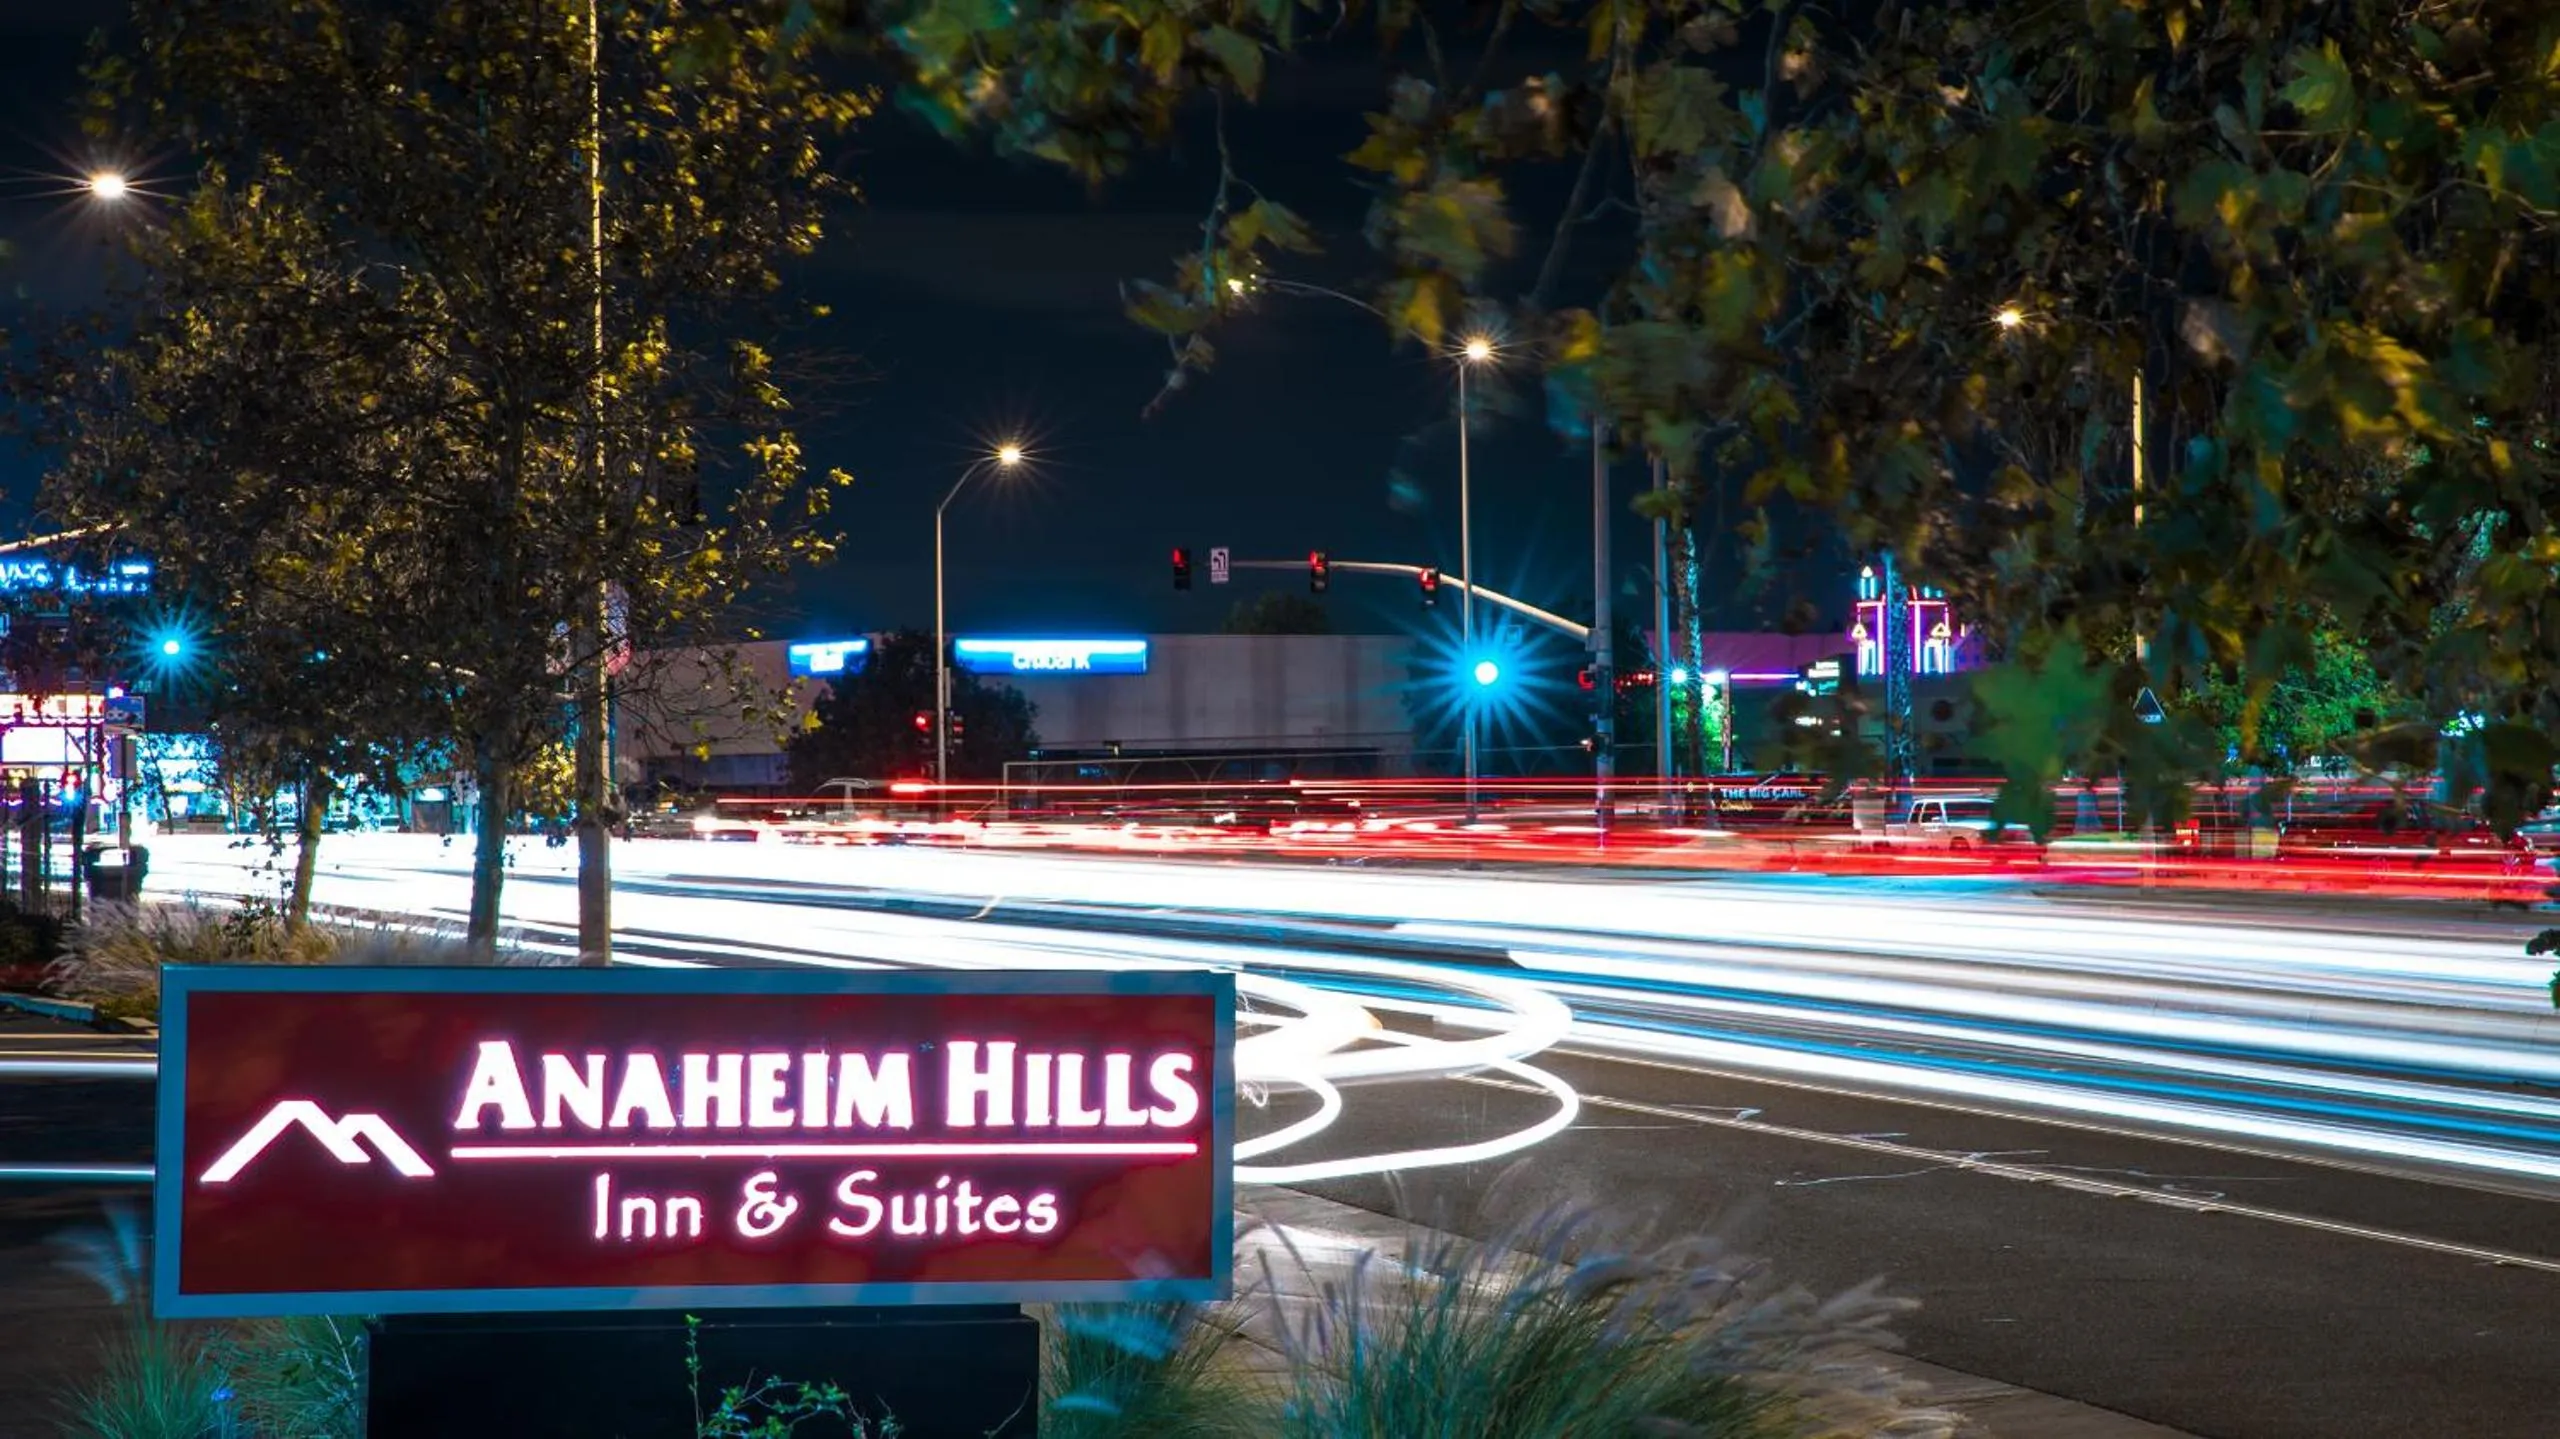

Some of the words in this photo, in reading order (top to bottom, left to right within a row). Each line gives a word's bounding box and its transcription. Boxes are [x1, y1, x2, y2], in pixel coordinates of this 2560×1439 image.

[1719, 788, 1745, 799] THE
[453, 1040, 914, 1130] ANAHEIM
[945, 1040, 1199, 1128] HILLS
[594, 1172, 704, 1239] Inn
[736, 1171, 799, 1238] &
[829, 1170, 1059, 1236] Suites
